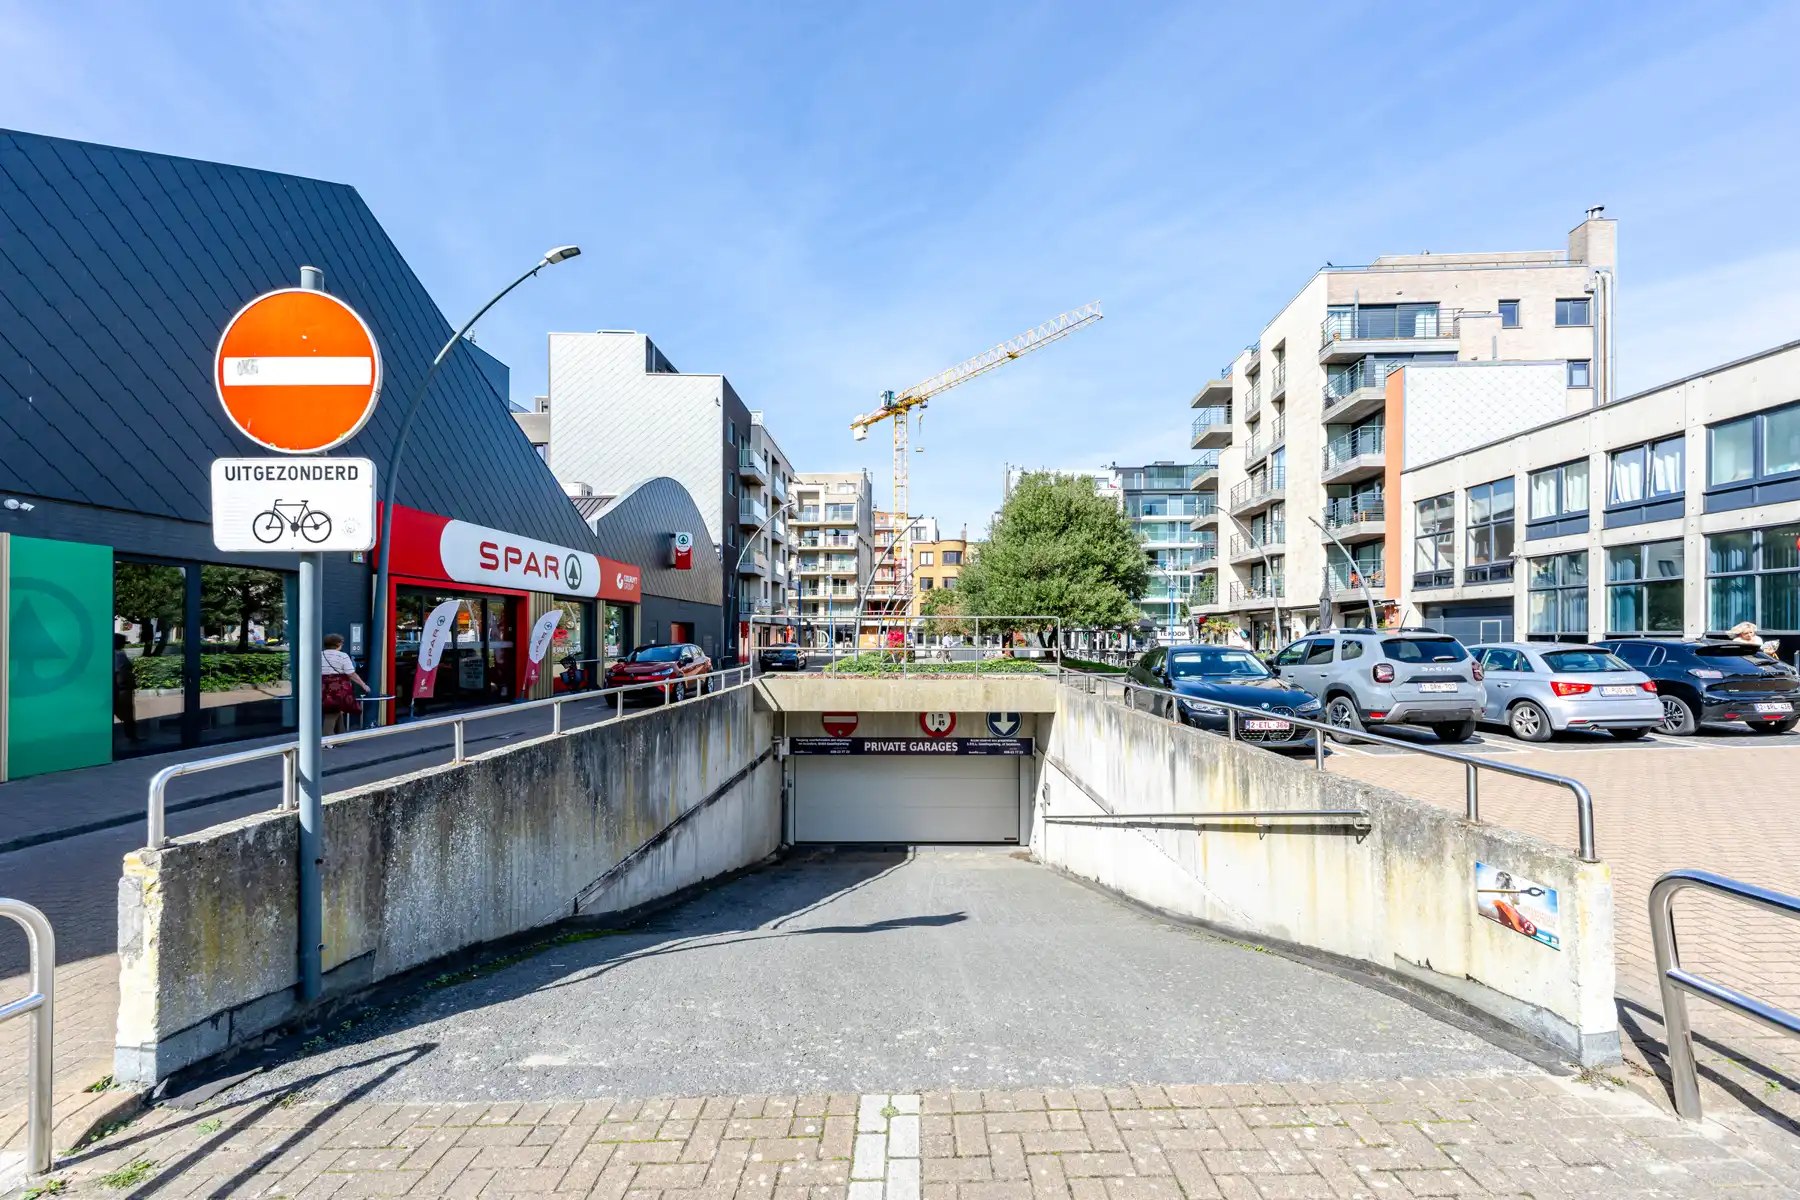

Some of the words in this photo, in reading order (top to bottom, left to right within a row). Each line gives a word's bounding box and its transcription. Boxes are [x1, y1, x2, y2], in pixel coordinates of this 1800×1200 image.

[224, 466, 359, 481] UITGEZONDERD
[479, 541, 560, 580] SPAR
[1250, 721, 1289, 729] 2-ETL-366
[864, 741, 906, 752] PRIVATE
[909, 741, 959, 752] GARAGES
